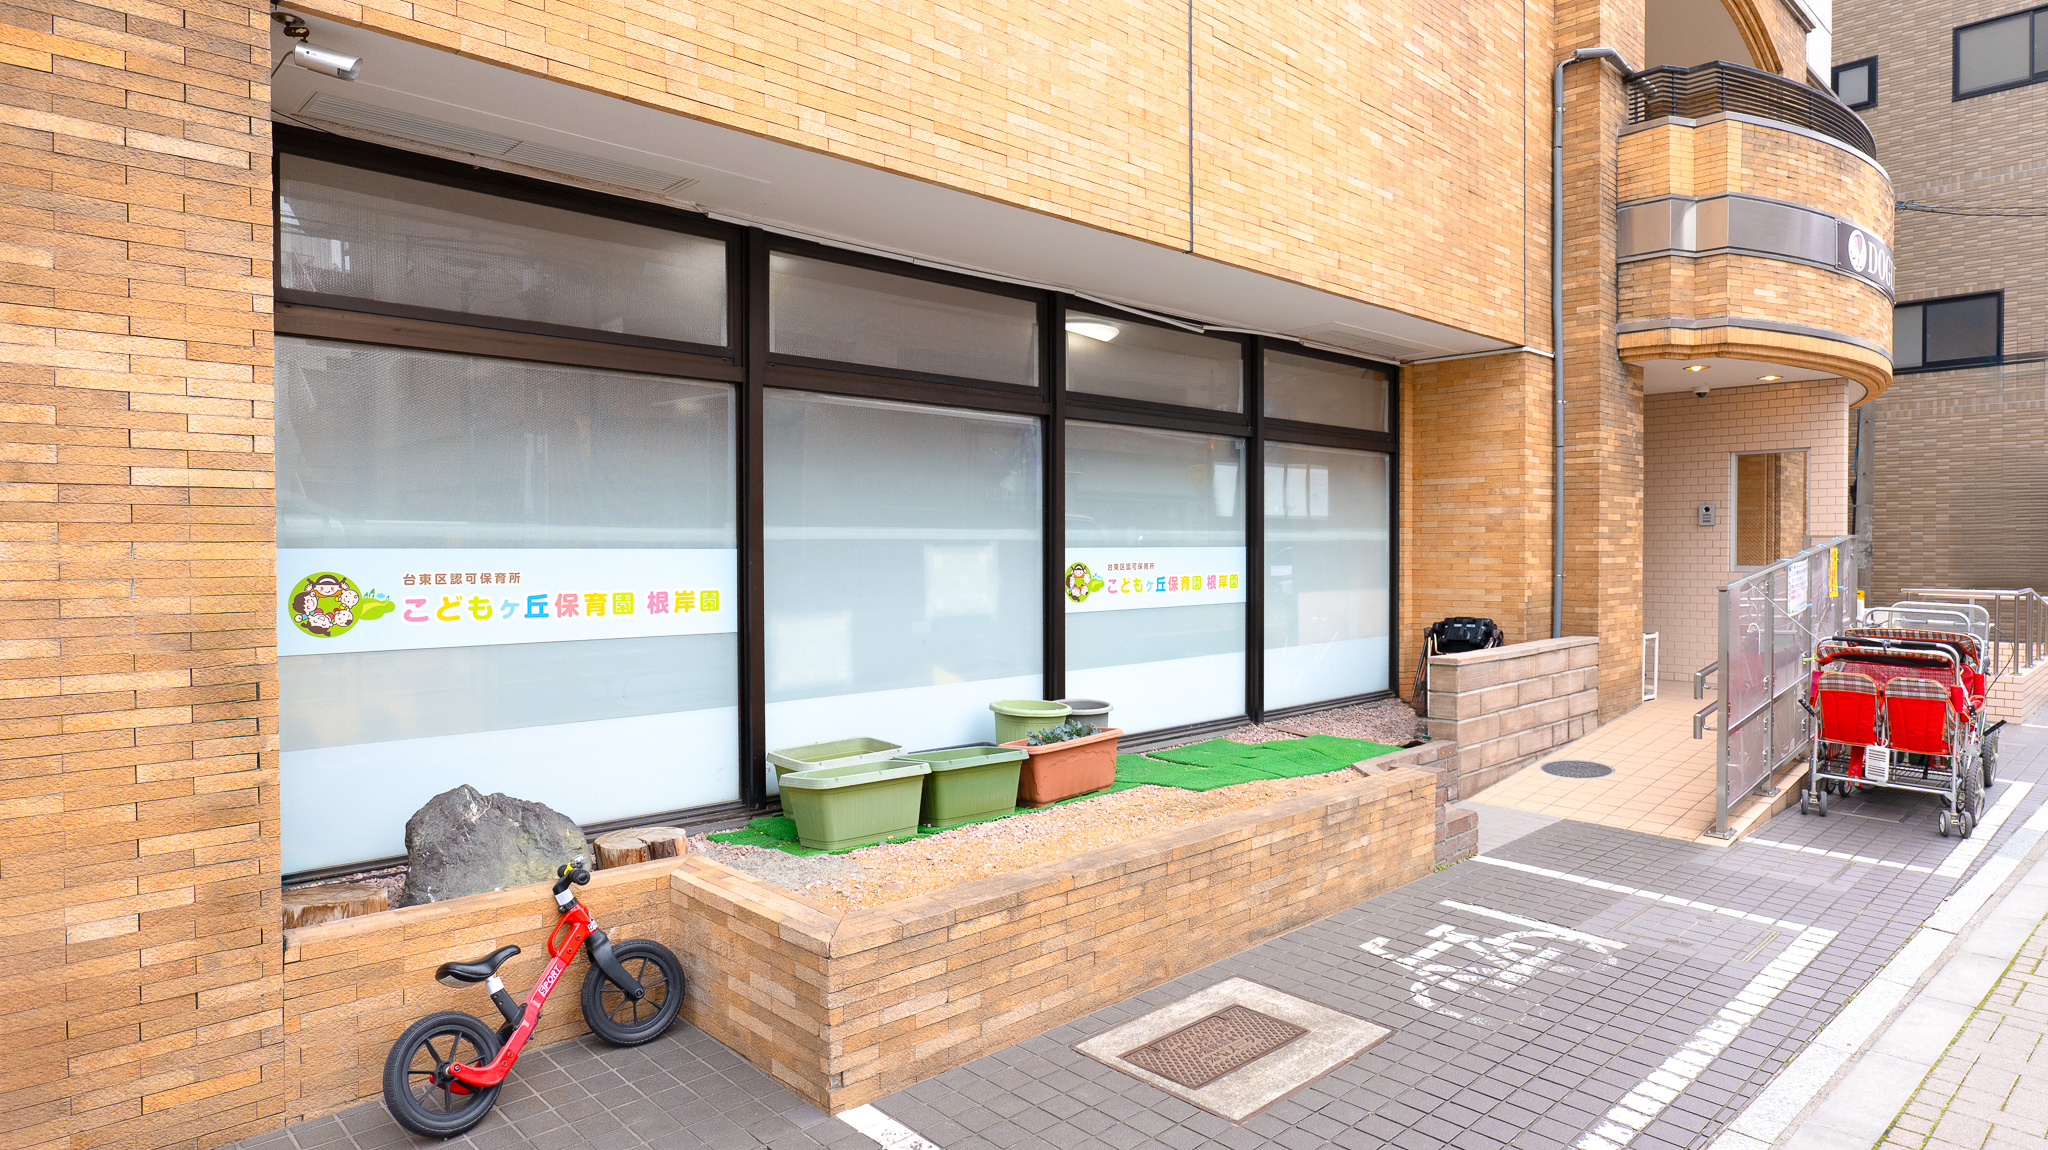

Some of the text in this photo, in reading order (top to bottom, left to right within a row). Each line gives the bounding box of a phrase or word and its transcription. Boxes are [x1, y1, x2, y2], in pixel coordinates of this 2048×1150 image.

[1107, 562, 1155, 571] 台東区認可保育所
[402, 572, 522, 586] 台東区認可保育所
[1206, 574, 1239, 590] 根岸園
[646, 590, 720, 614] 根岸園
[538, 965, 563, 997] SPORT
